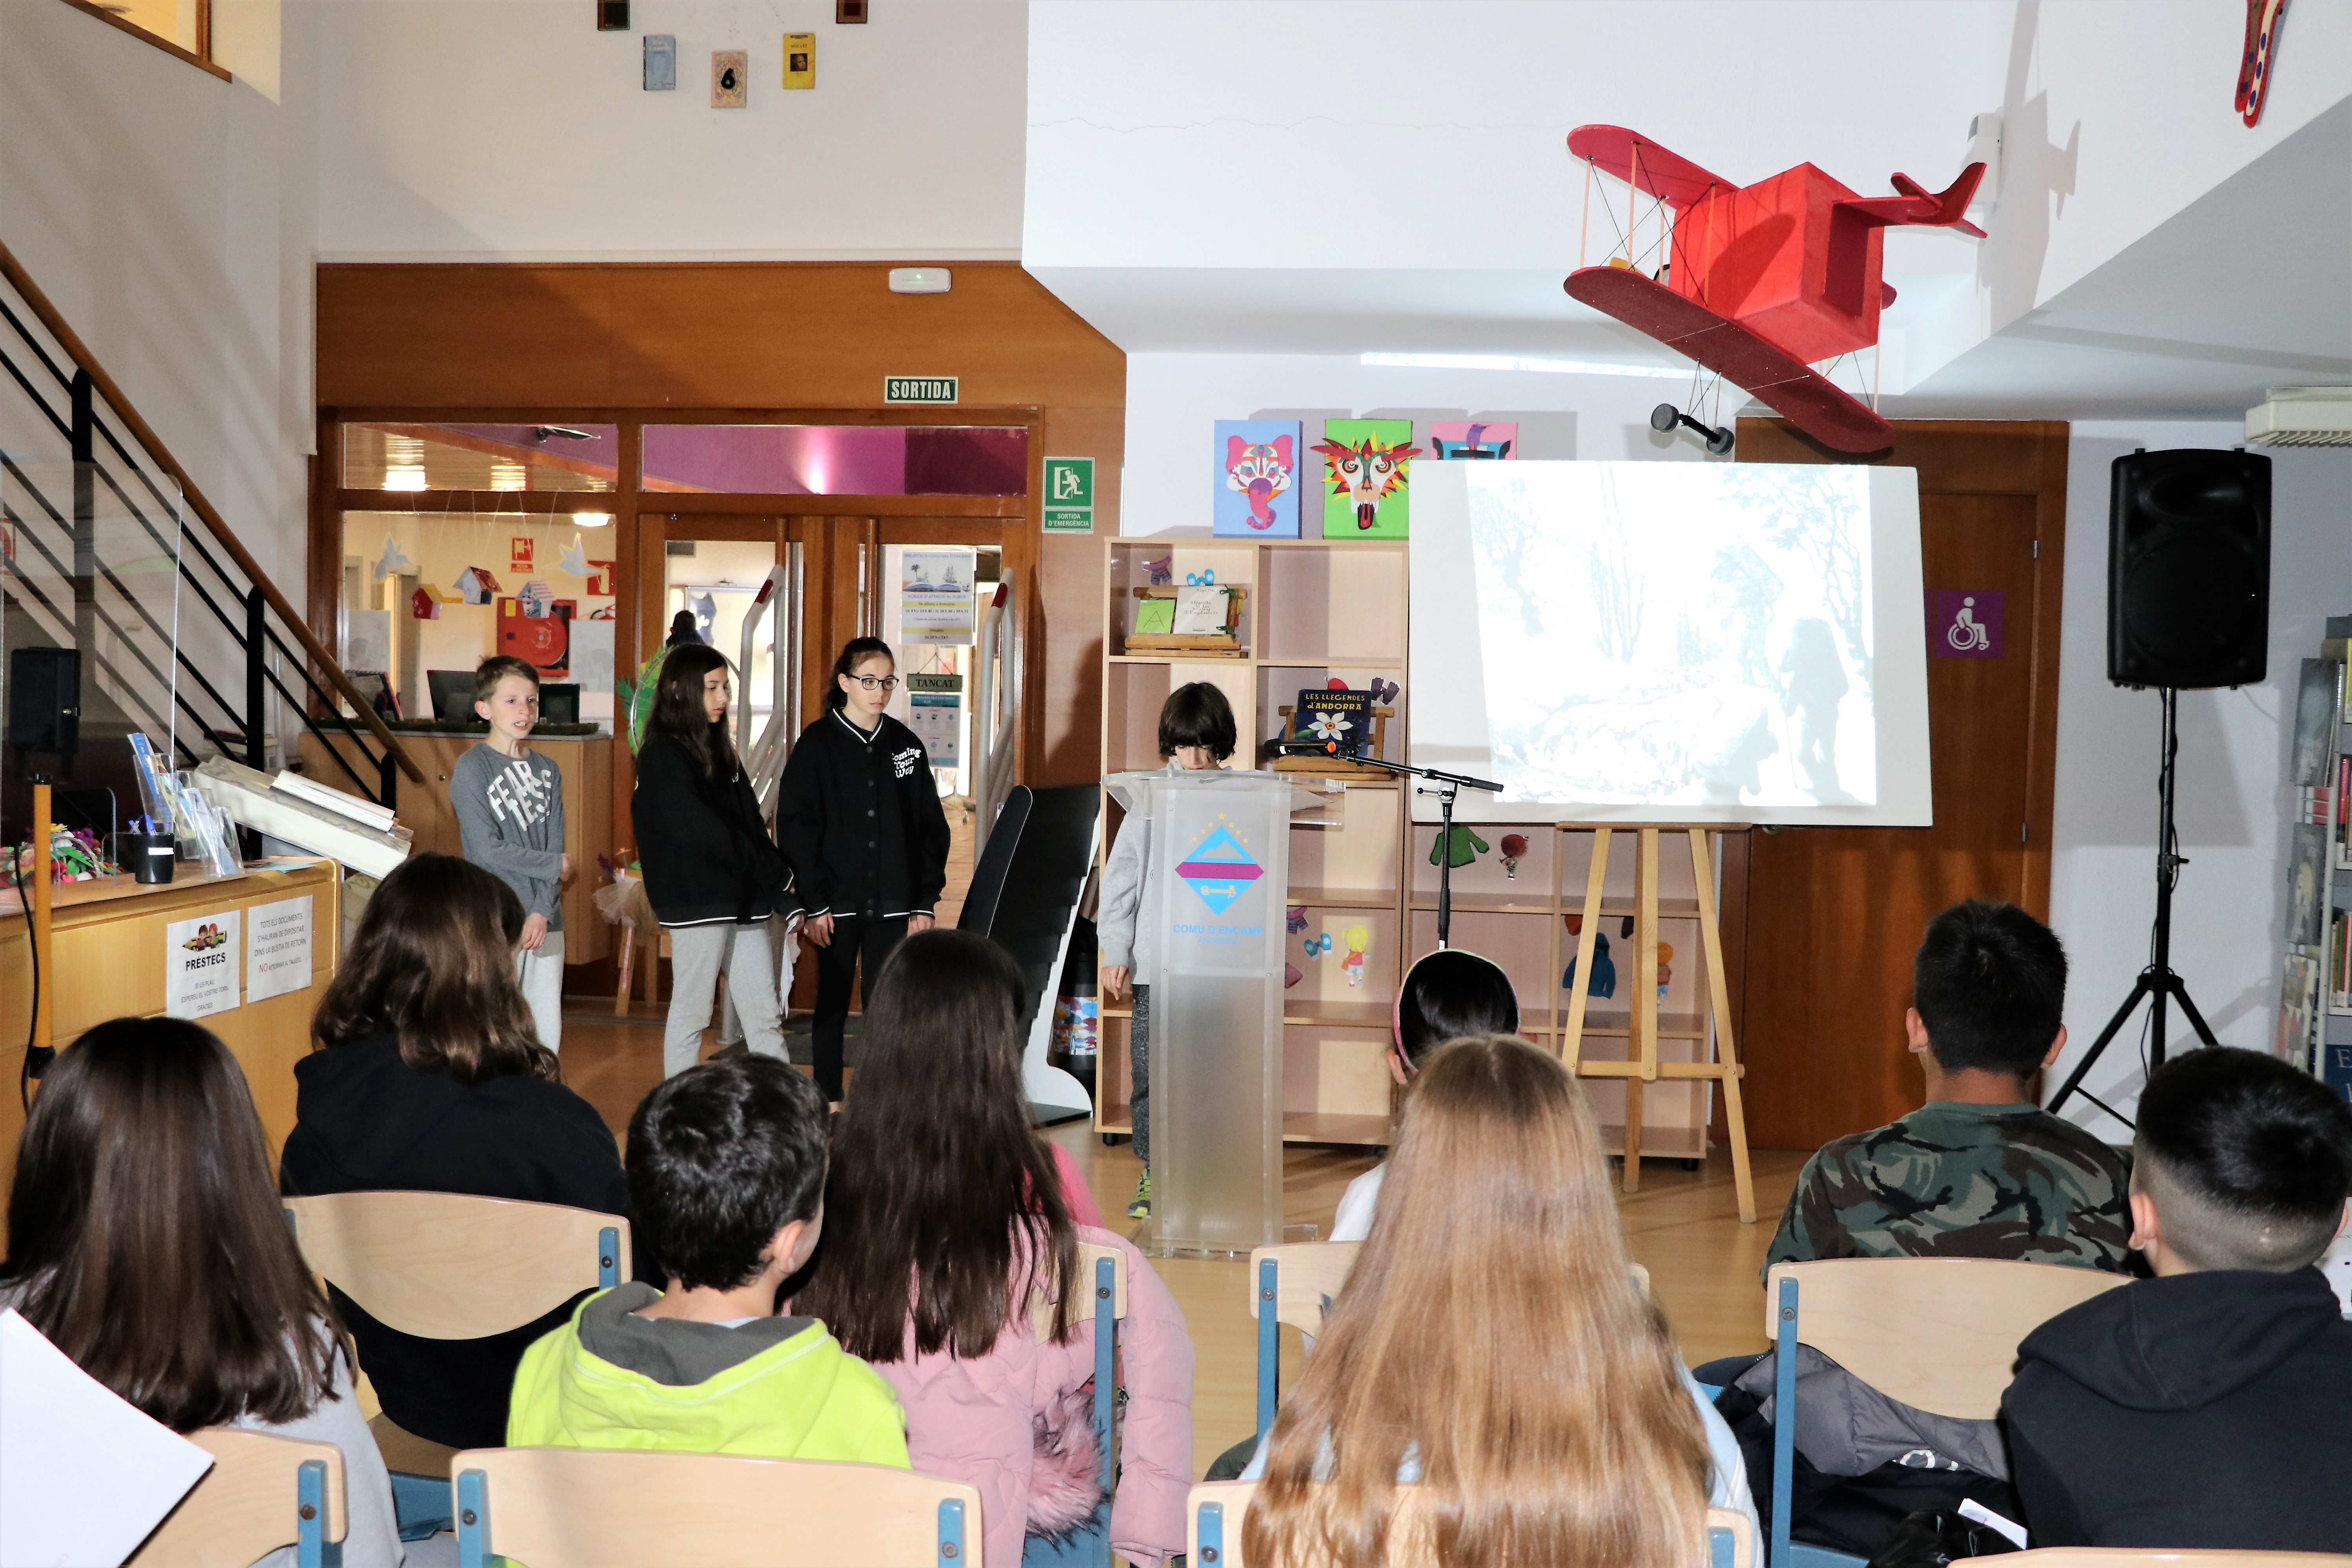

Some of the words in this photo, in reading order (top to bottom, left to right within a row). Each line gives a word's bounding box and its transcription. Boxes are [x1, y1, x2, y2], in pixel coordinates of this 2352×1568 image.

[891, 381, 951, 399] SORTIDA
[916, 679, 954, 688] TANCAT
[1307, 702, 1362, 710] d'ANDORRA
[894, 757, 915, 769] Your
[895, 766, 914, 778] Way
[260, 920, 270, 928] TOTS
[278, 913, 303, 924] DOCUMENTS
[258, 932, 278, 942] S'HAURAN
[284, 926, 305, 936] DIPOSITAR
[1208, 925, 1264, 935] D'ENCAMP
[255, 948, 265, 956] DINS
[290, 938, 307, 947] RETORN
[186, 953, 226, 971] PRÉSTECS
[259, 963, 268, 973] NO
[181, 993, 199, 1003] ESPEREU
[204, 988, 218, 997] VOSTRE
